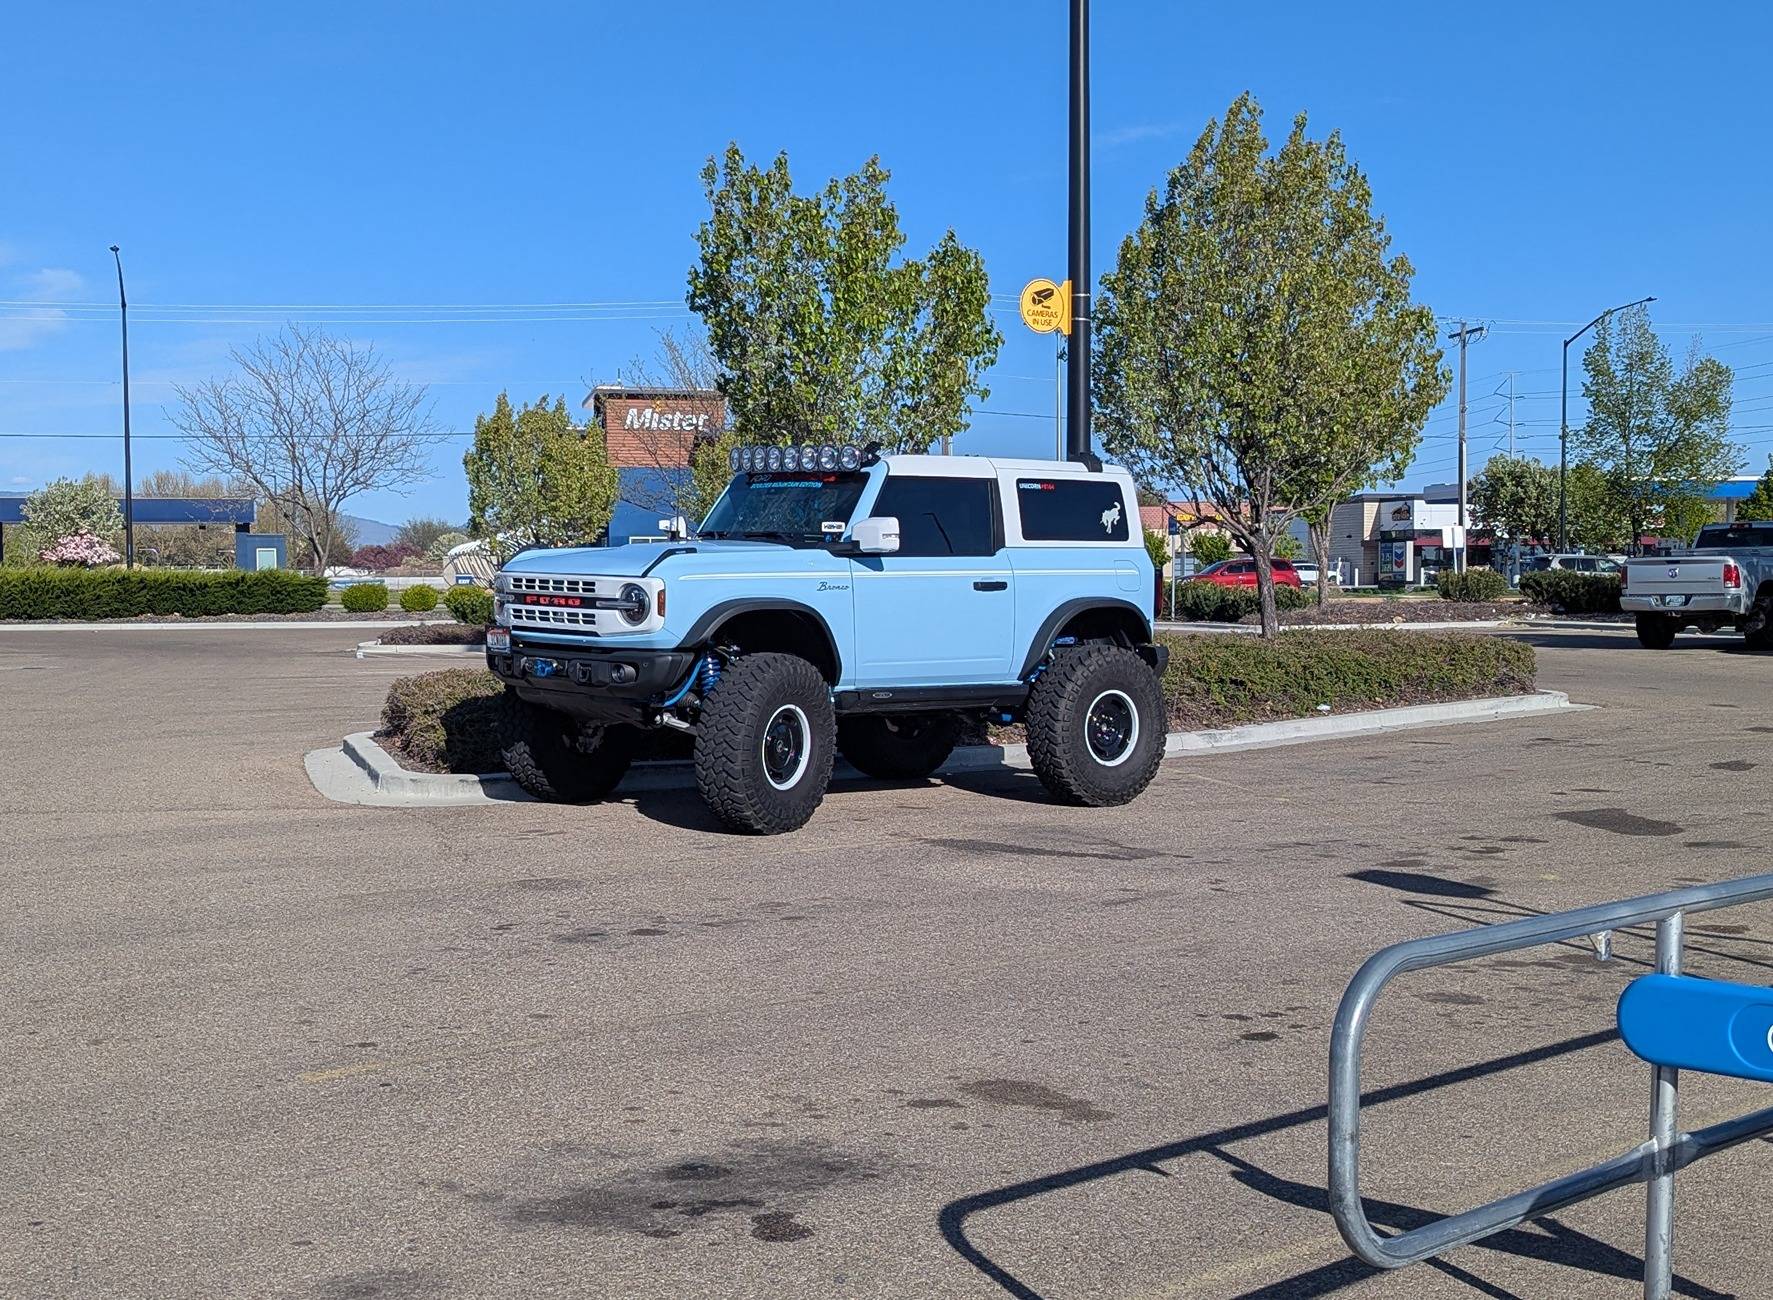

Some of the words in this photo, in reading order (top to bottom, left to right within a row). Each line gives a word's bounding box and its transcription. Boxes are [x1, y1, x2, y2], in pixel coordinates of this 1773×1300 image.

[1026, 309, 1059, 319] CAMERAS
[1032, 318, 1040, 326] IN
[1041, 319, 1053, 327] USE
[624, 408, 709, 431] Mister
[816, 581, 850, 592] Bronco
[525, 595, 581, 606] FORD
